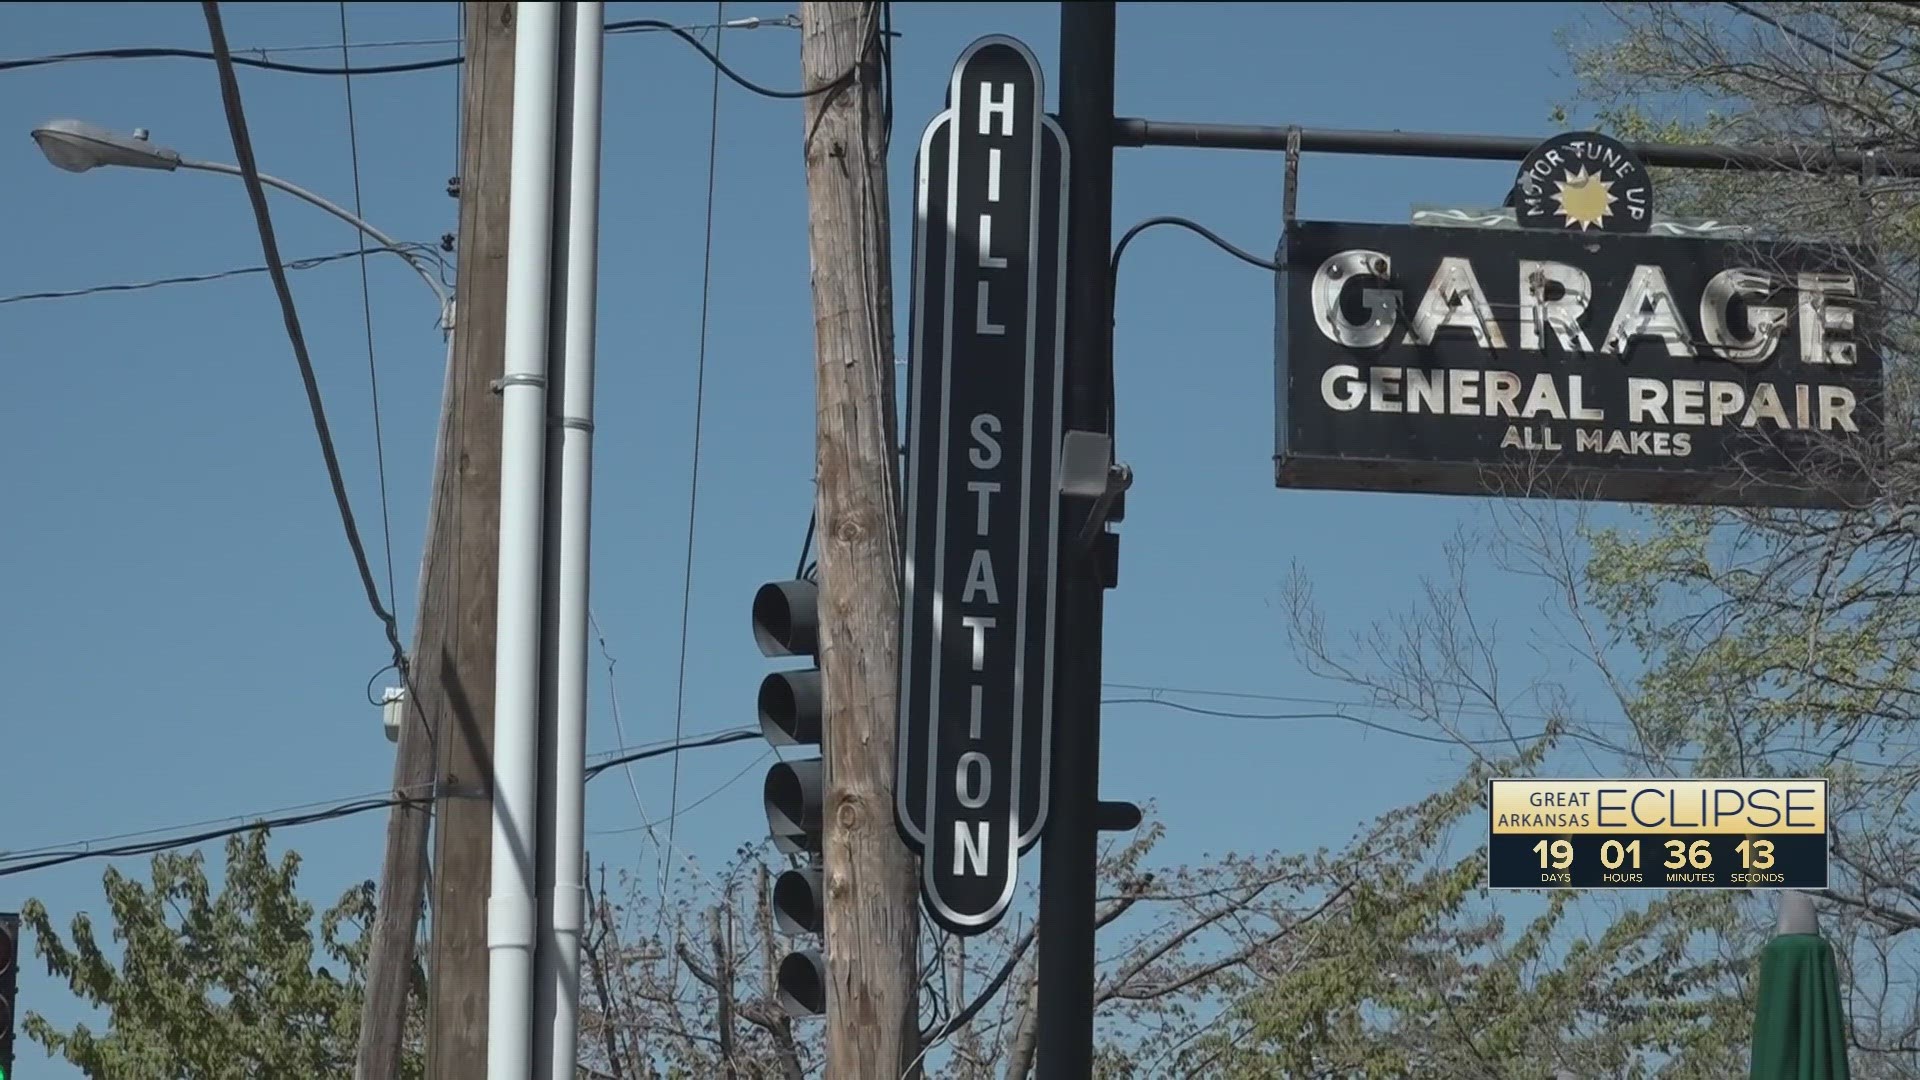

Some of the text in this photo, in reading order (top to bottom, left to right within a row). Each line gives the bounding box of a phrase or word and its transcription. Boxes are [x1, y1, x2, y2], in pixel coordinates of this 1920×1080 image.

[1523, 141, 1645, 220] MOTOR TUNE UP
[1311, 249, 1858, 365] GARAGE
[1320, 365, 1859, 432] GENERAL REPAIR
[952, 80, 1015, 877] HILL STATION
[1500, 425, 1692, 457] ALL MAKES
